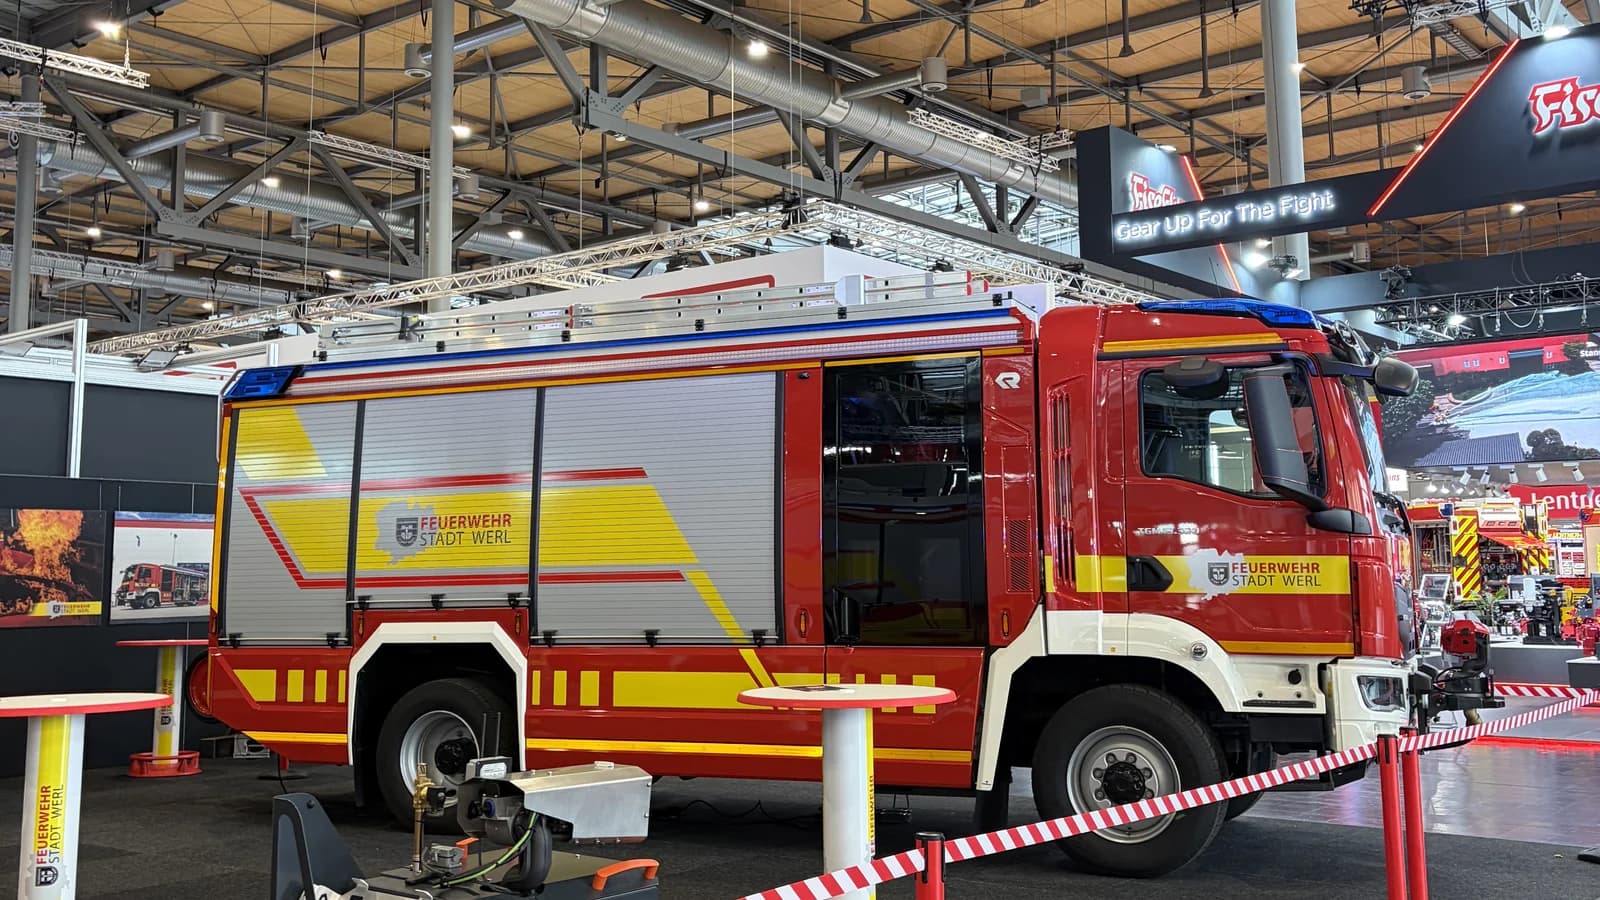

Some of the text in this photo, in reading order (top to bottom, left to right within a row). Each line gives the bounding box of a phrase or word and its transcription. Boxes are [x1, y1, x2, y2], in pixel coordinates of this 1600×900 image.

[1116, 189, 1336, 241] Gear Up For The Fight
[420, 513, 512, 530] FEUERWEHR
[420, 530, 512, 547] STADT WERL
[1232, 562, 1320, 574] FEUERWEHR
[1232, 575, 1322, 587] STADT WERL
[36, 785, 52, 865] FEUERWEHR
[48, 784, 65, 864] STADT WERL
